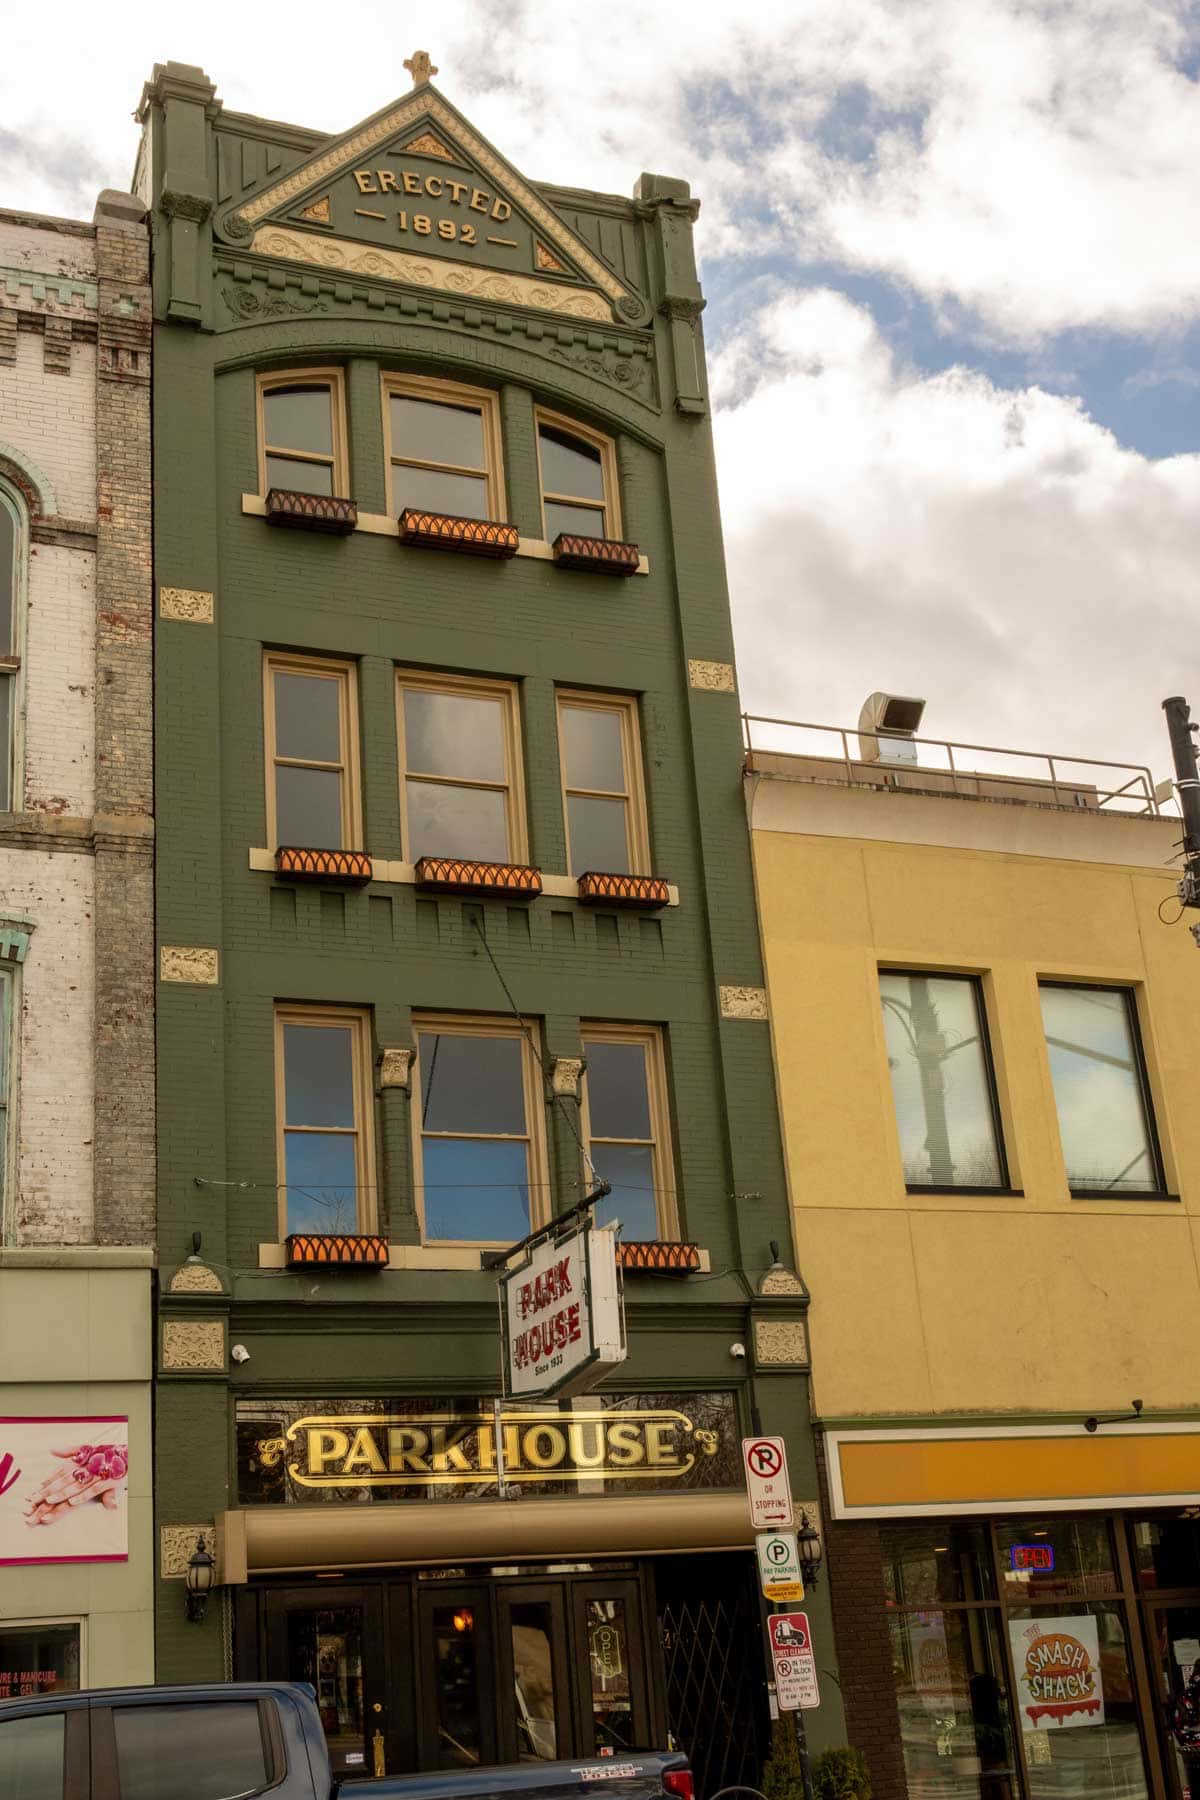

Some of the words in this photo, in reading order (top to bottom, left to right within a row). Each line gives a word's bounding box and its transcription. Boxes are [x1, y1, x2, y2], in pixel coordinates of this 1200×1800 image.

[353, 170, 512, 222] ERECTED
[398, 210, 478, 245] 1892
[517, 1256, 573, 1320] PARK
[513, 1302, 582, 1370] HOUSE
[535, 1363, 549, 1376] Since
[308, 1422, 680, 1474] PARKHOUSE
[764, 1485, 773, 1494] OR
[755, 1499, 786, 1510] STOPPING
[774, 1566, 798, 1574] PARKING
[1014, 1547, 1051, 1568] OPEN
[1028, 1641, 1084, 1672] SMASH
[20, 1670, 57, 1683] MANICURE
[1032, 1671, 1090, 1699] SHACK
